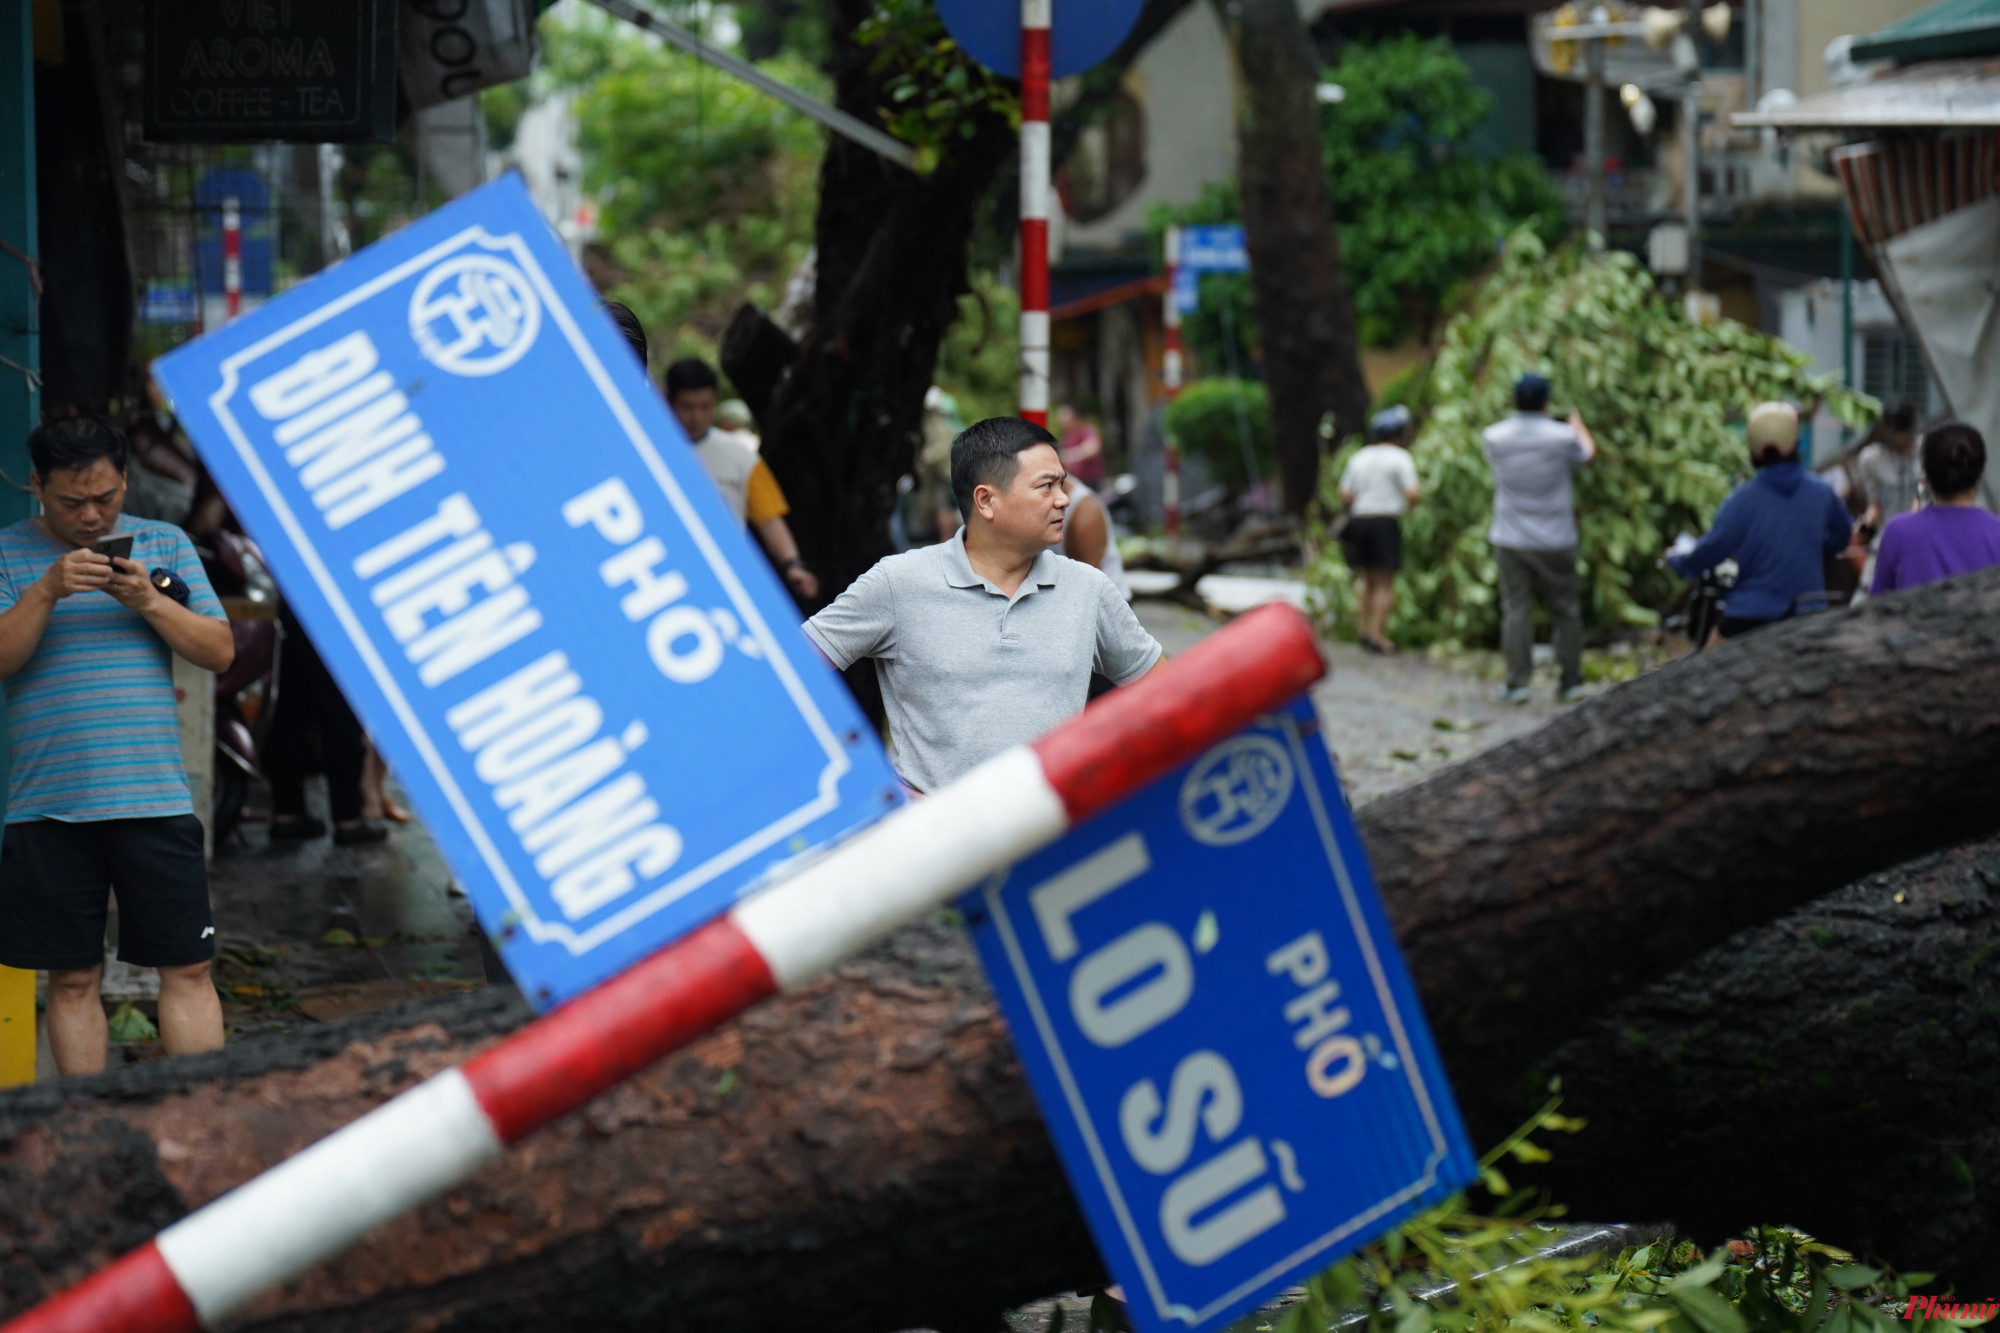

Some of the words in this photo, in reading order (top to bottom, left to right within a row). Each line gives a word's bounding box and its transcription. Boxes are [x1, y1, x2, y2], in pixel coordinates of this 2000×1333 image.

[169, 87, 272, 117] COFFEE
[296, 86, 344, 115] TEA
[180, 36, 336, 79] AROMA
[248, 330, 447, 531] ĐINH
[352, 491, 543, 689] TIÊN
[560, 477, 764, 684] PHỐ
[445, 650, 684, 921] HOÀNG
[1028, 831, 1220, 1049] LÒ
[1265, 930, 1397, 1099] PHỐ
[1119, 1049, 1305, 1266] SŨ
